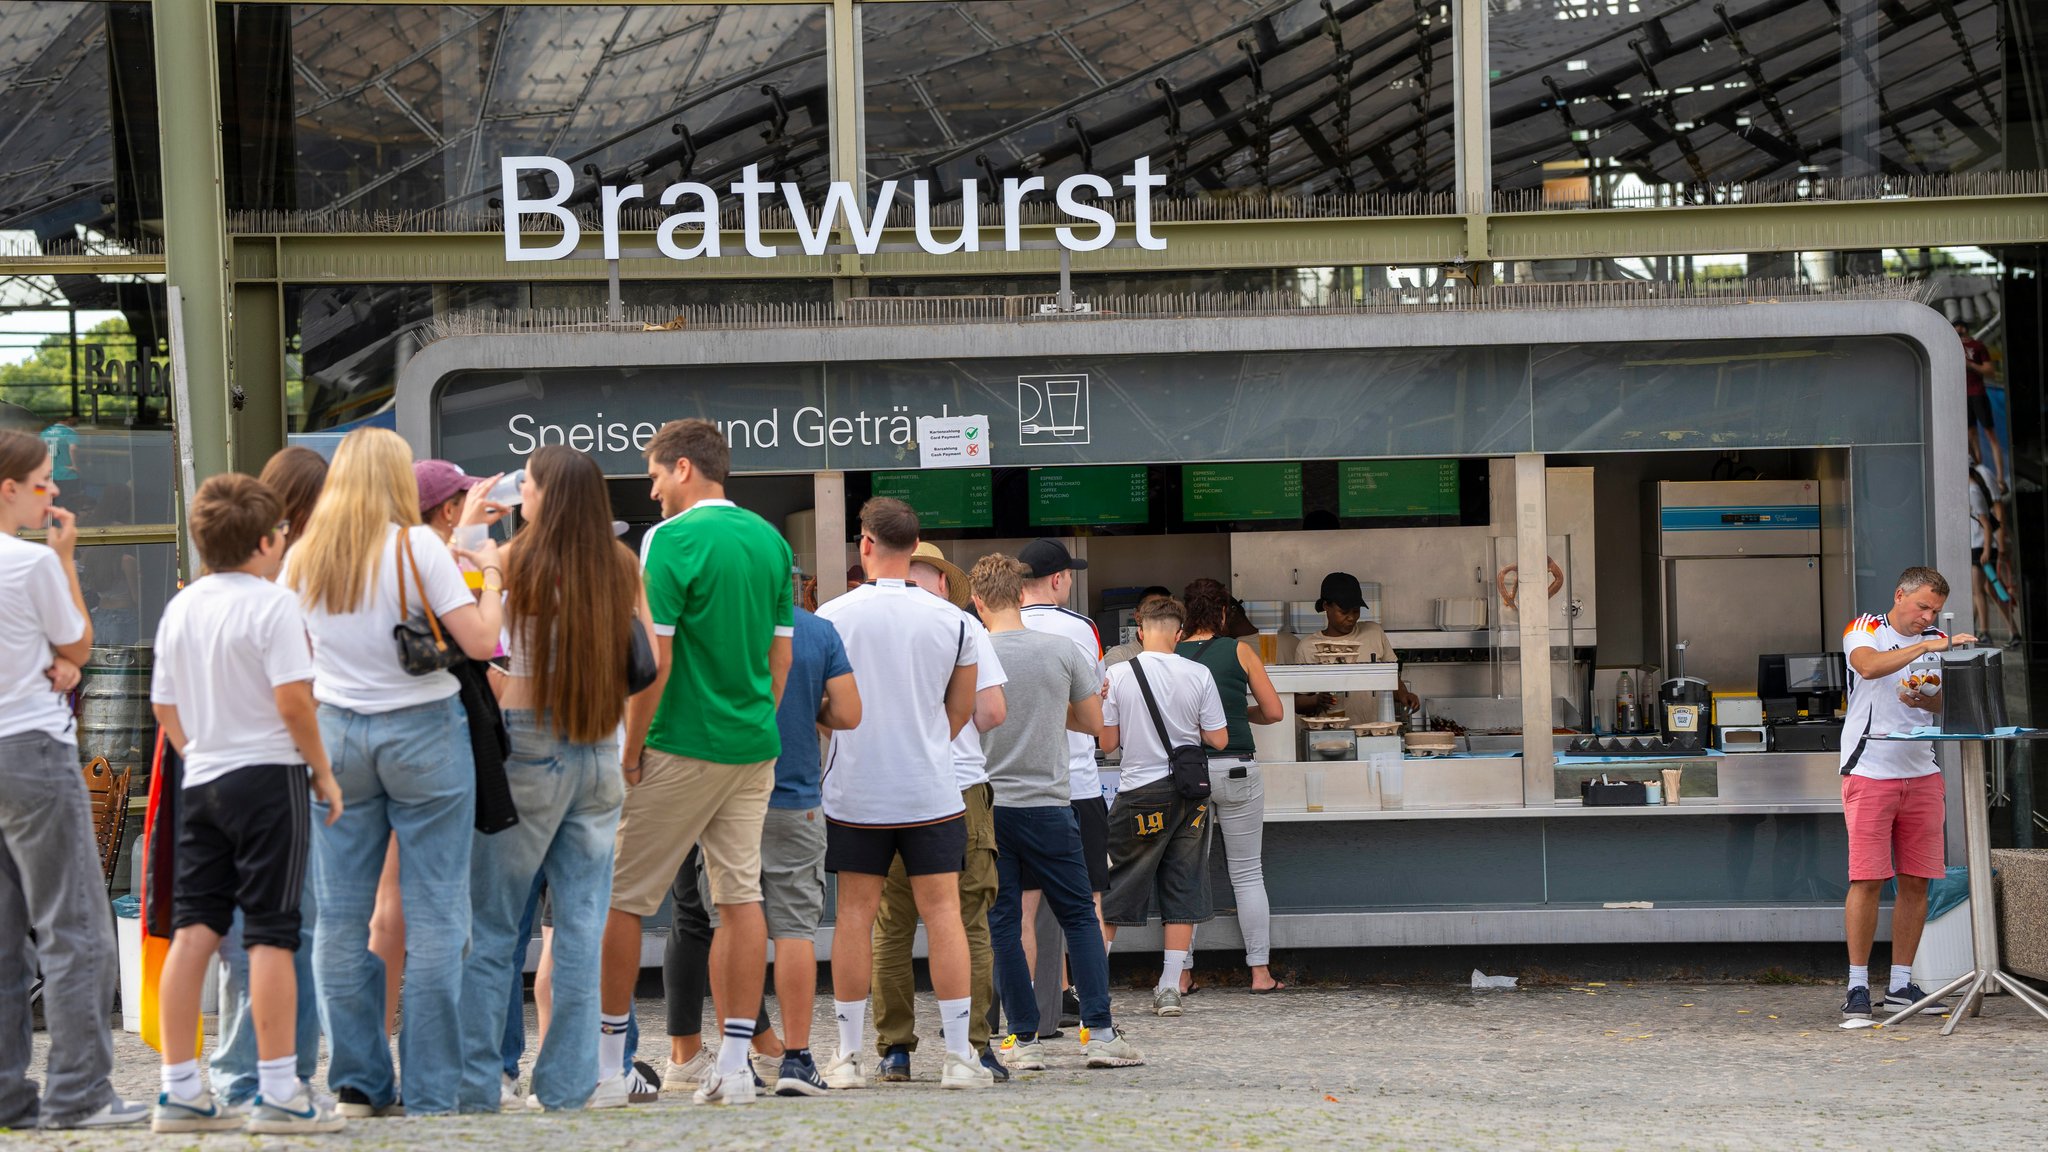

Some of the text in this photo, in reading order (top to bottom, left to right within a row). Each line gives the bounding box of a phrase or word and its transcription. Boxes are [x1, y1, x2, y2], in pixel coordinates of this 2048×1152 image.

[501, 155, 1168, 262] Bratwurst
[508, 404, 989, 455] Speise nd Geträ
[1134, 811, 1164, 836] 19
